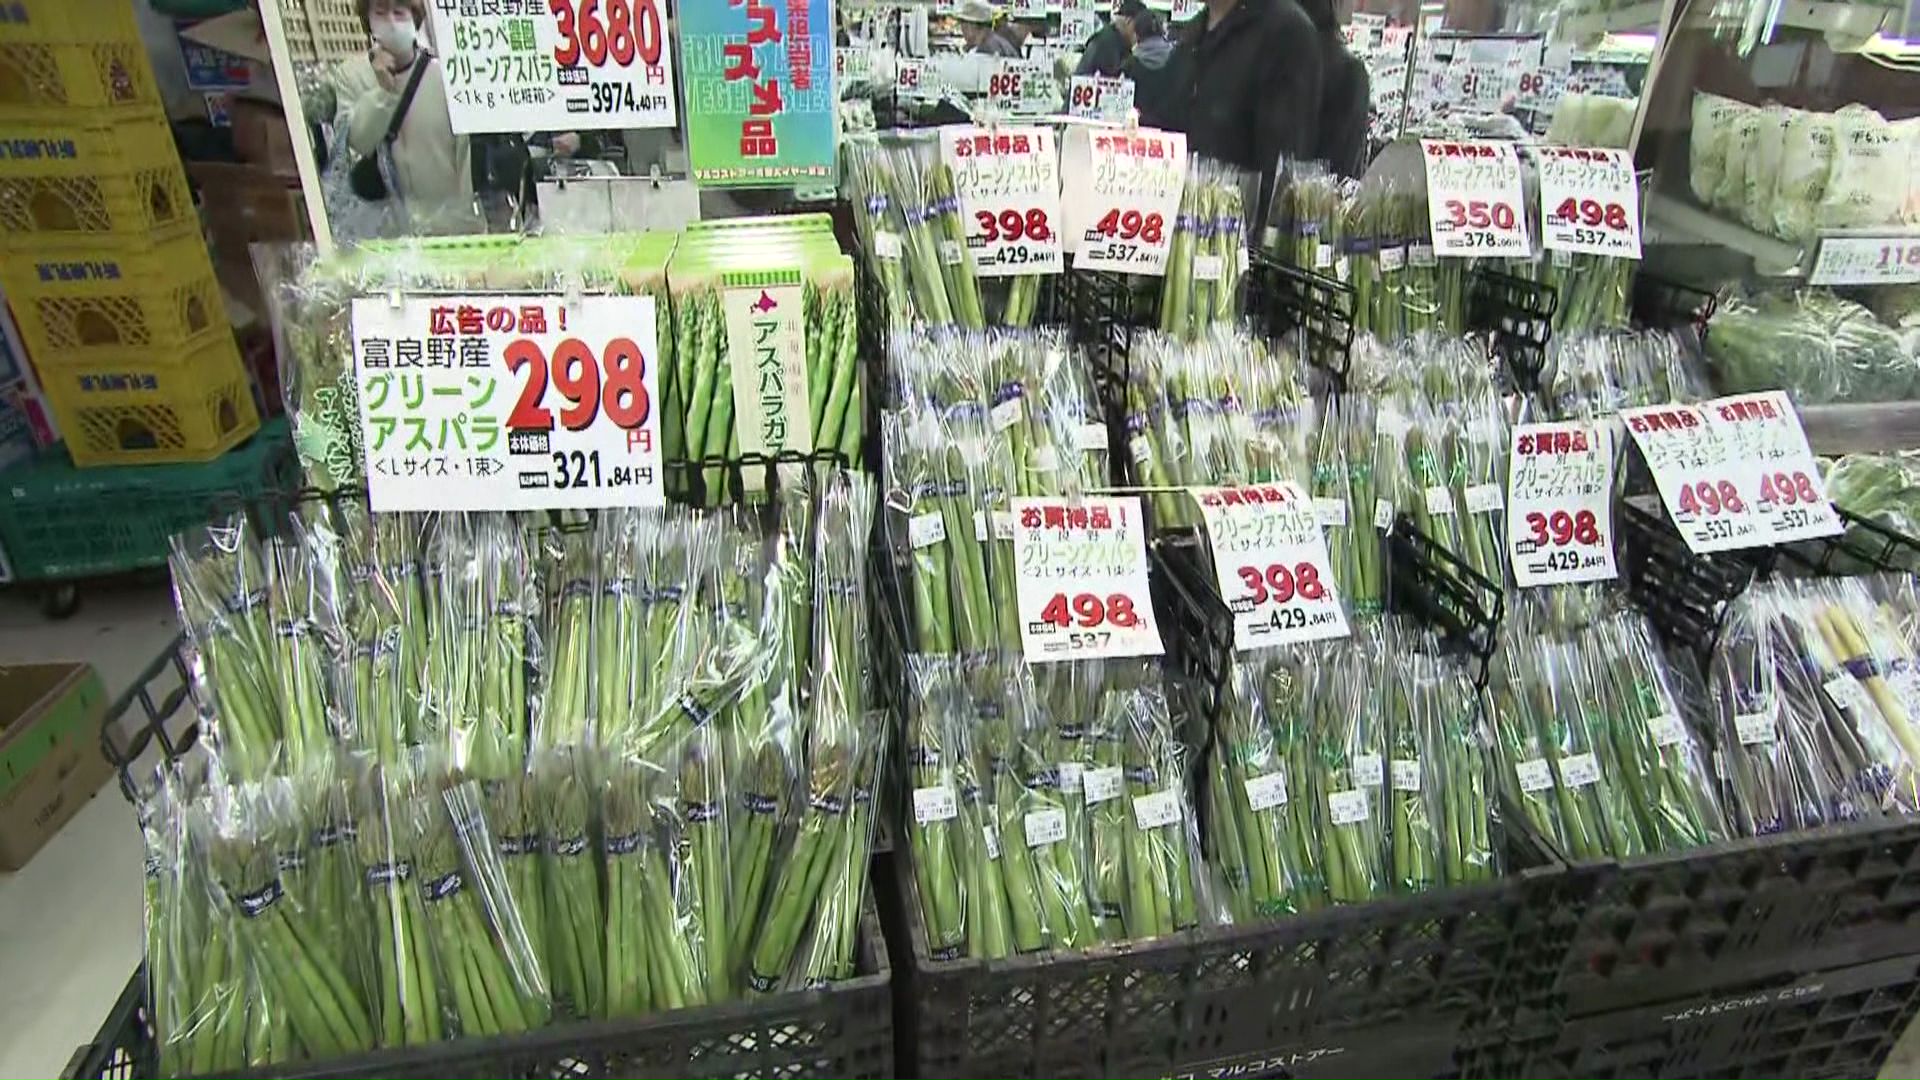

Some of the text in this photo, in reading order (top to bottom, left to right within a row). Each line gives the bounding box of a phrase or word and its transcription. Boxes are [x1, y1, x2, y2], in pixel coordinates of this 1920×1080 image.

[552, 0, 662, 68] 3680
[446, 54, 553, 84] グリーンアスパラ
[646, 66, 664, 84] 円
[724, 0, 783, 156] ススメ品
[955, 134, 1044, 158] お買得品！
[1095, 135, 1175, 159] お買得品！
[974, 207, 1051, 242] 398
[1097, 207, 1164, 243] 498
[1445, 199, 1515, 229] 350
[1556, 197, 1627, 229] 498
[429, 305, 568, 335] 広告の品！
[361, 337, 491, 368] 富良野産
[364, 373, 497, 411] グリーン
[502, 337, 651, 432] 298
[368, 412, 500, 452] アスパラ
[626, 430, 651, 454] 円
[1517, 429, 1600, 455] お買得品！
[1679, 471, 1818, 516] 498 498
[1021, 505, 1127, 530] お買得品！
[1526, 509, 1599, 547] 398
[1237, 562, 1324, 606] 398
[1041, 593, 1137, 628] 498
[1207, 1046, 1345, 1079] マルコストアー
